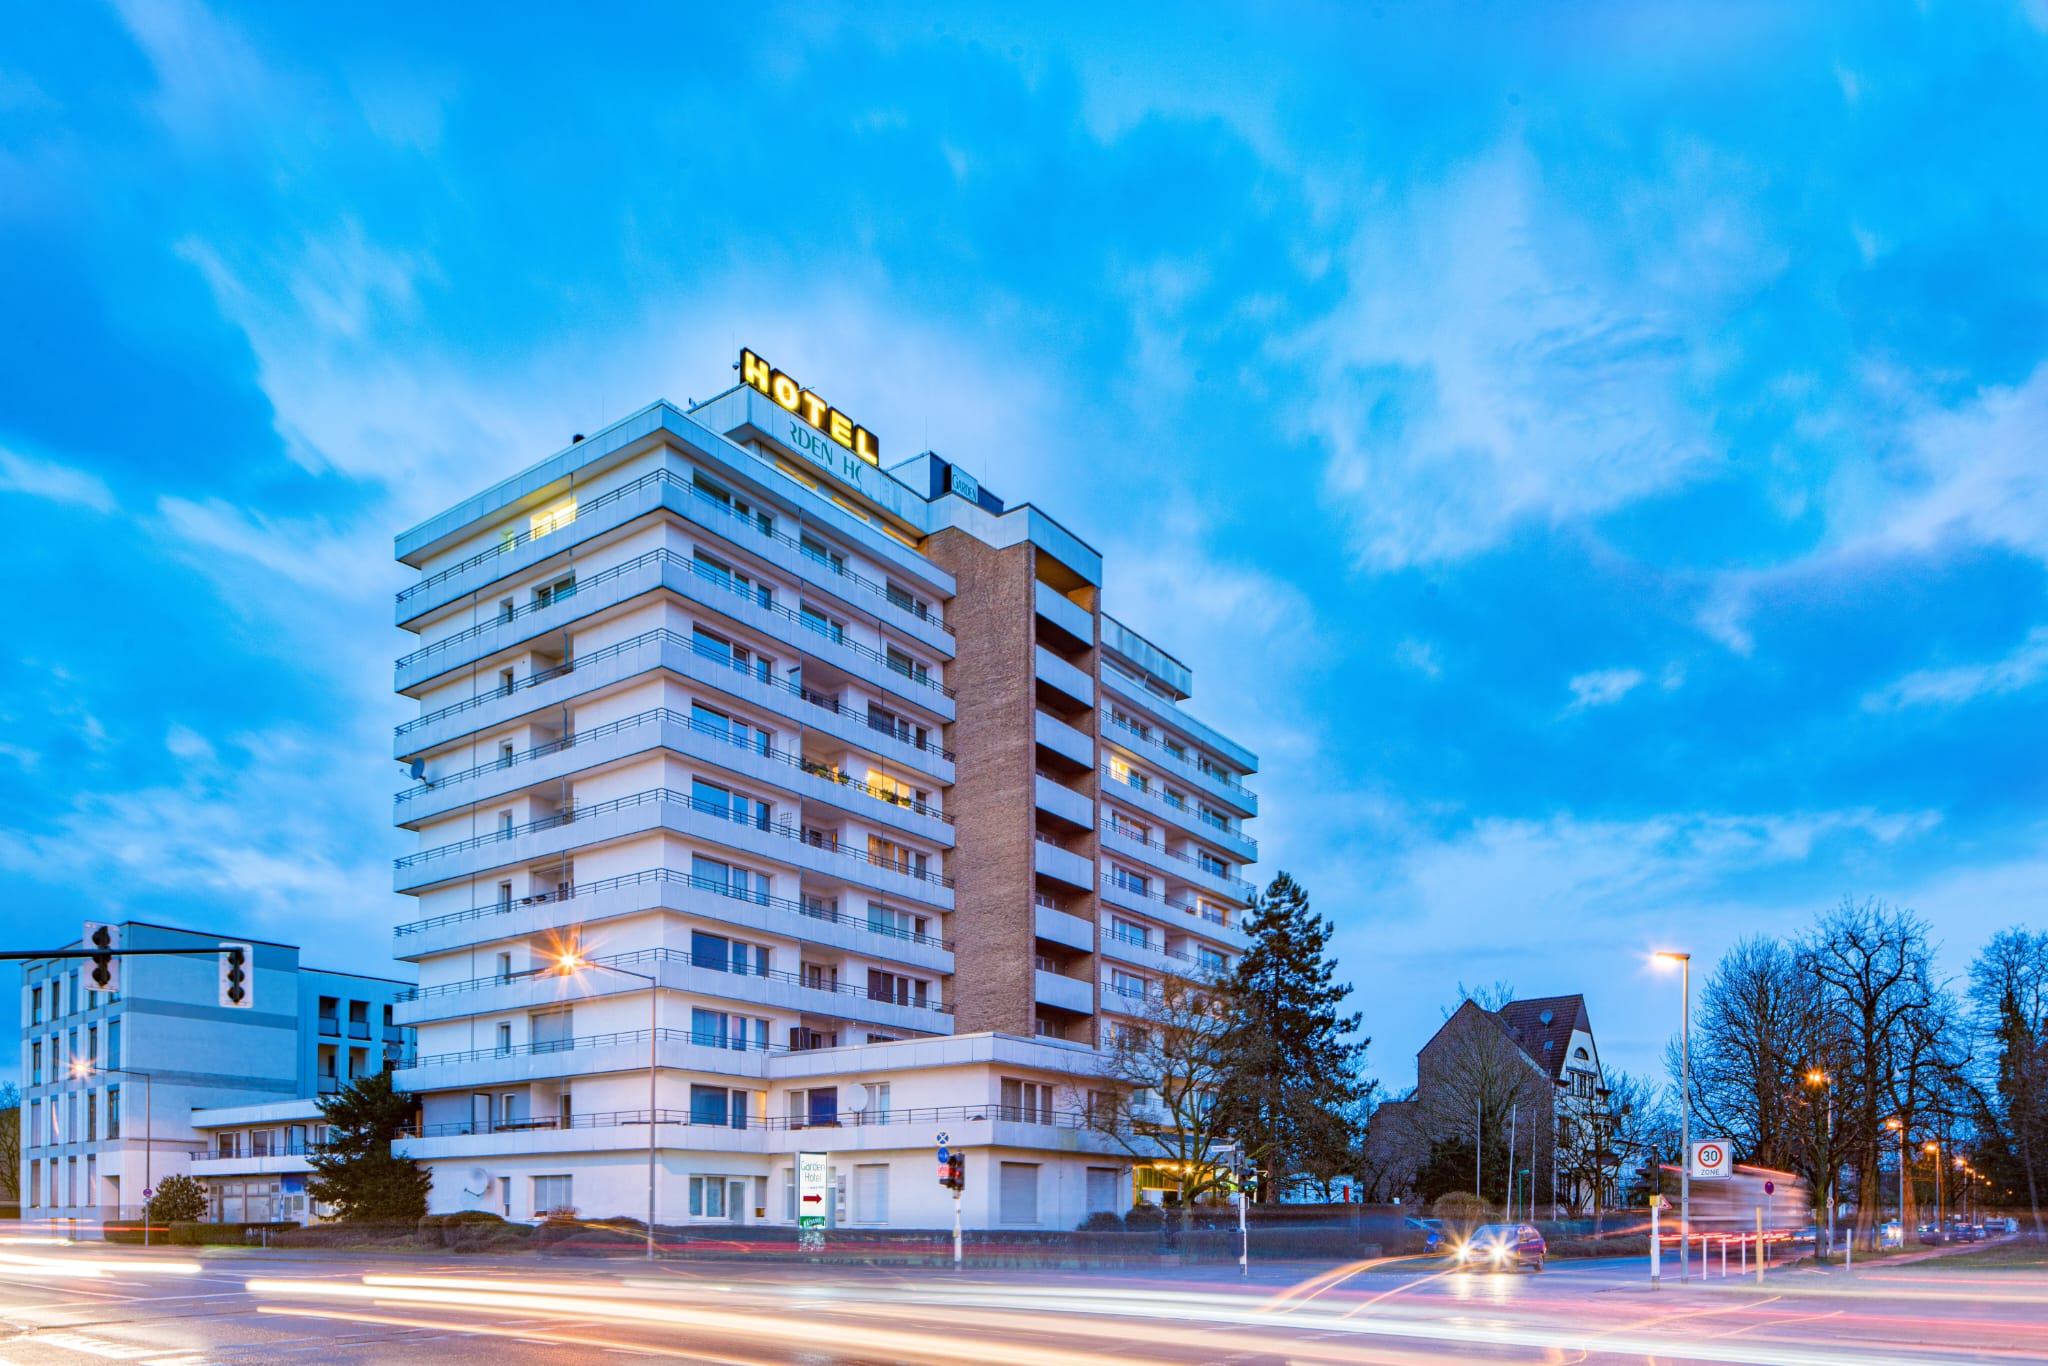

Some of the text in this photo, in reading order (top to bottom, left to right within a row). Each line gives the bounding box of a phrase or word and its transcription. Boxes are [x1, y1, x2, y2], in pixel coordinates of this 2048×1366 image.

[744, 351, 878, 466] HOTEL
[952, 473, 977, 502] GARDEN
[1703, 1150, 1718, 1162] 30
[800, 1160, 826, 1172] Garden
[804, 1172, 822, 1183] Hotel
